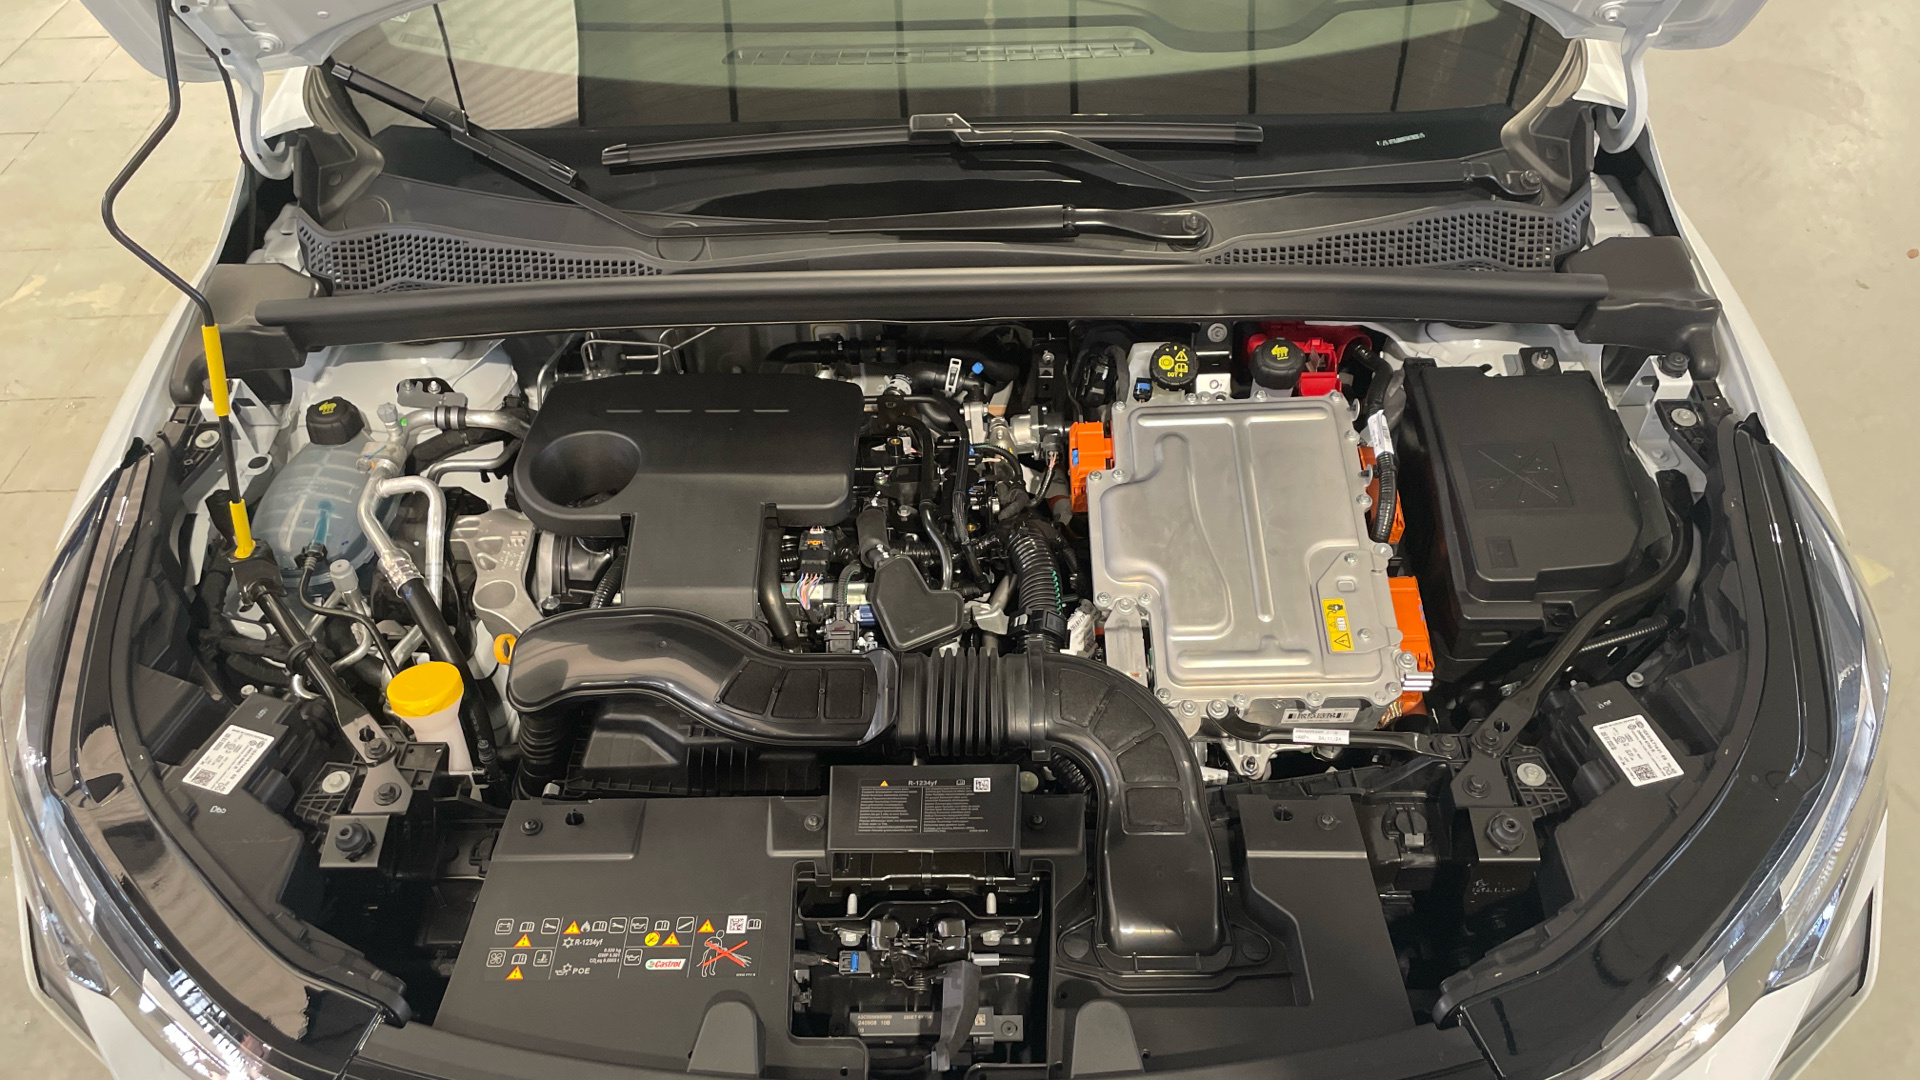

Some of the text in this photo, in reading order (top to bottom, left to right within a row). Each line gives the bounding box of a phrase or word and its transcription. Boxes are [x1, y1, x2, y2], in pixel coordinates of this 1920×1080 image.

[574, 938, 604, 948] R-1234yf
[654, 960, 682, 968] Castrol
[572, 967, 590, 975] POE
